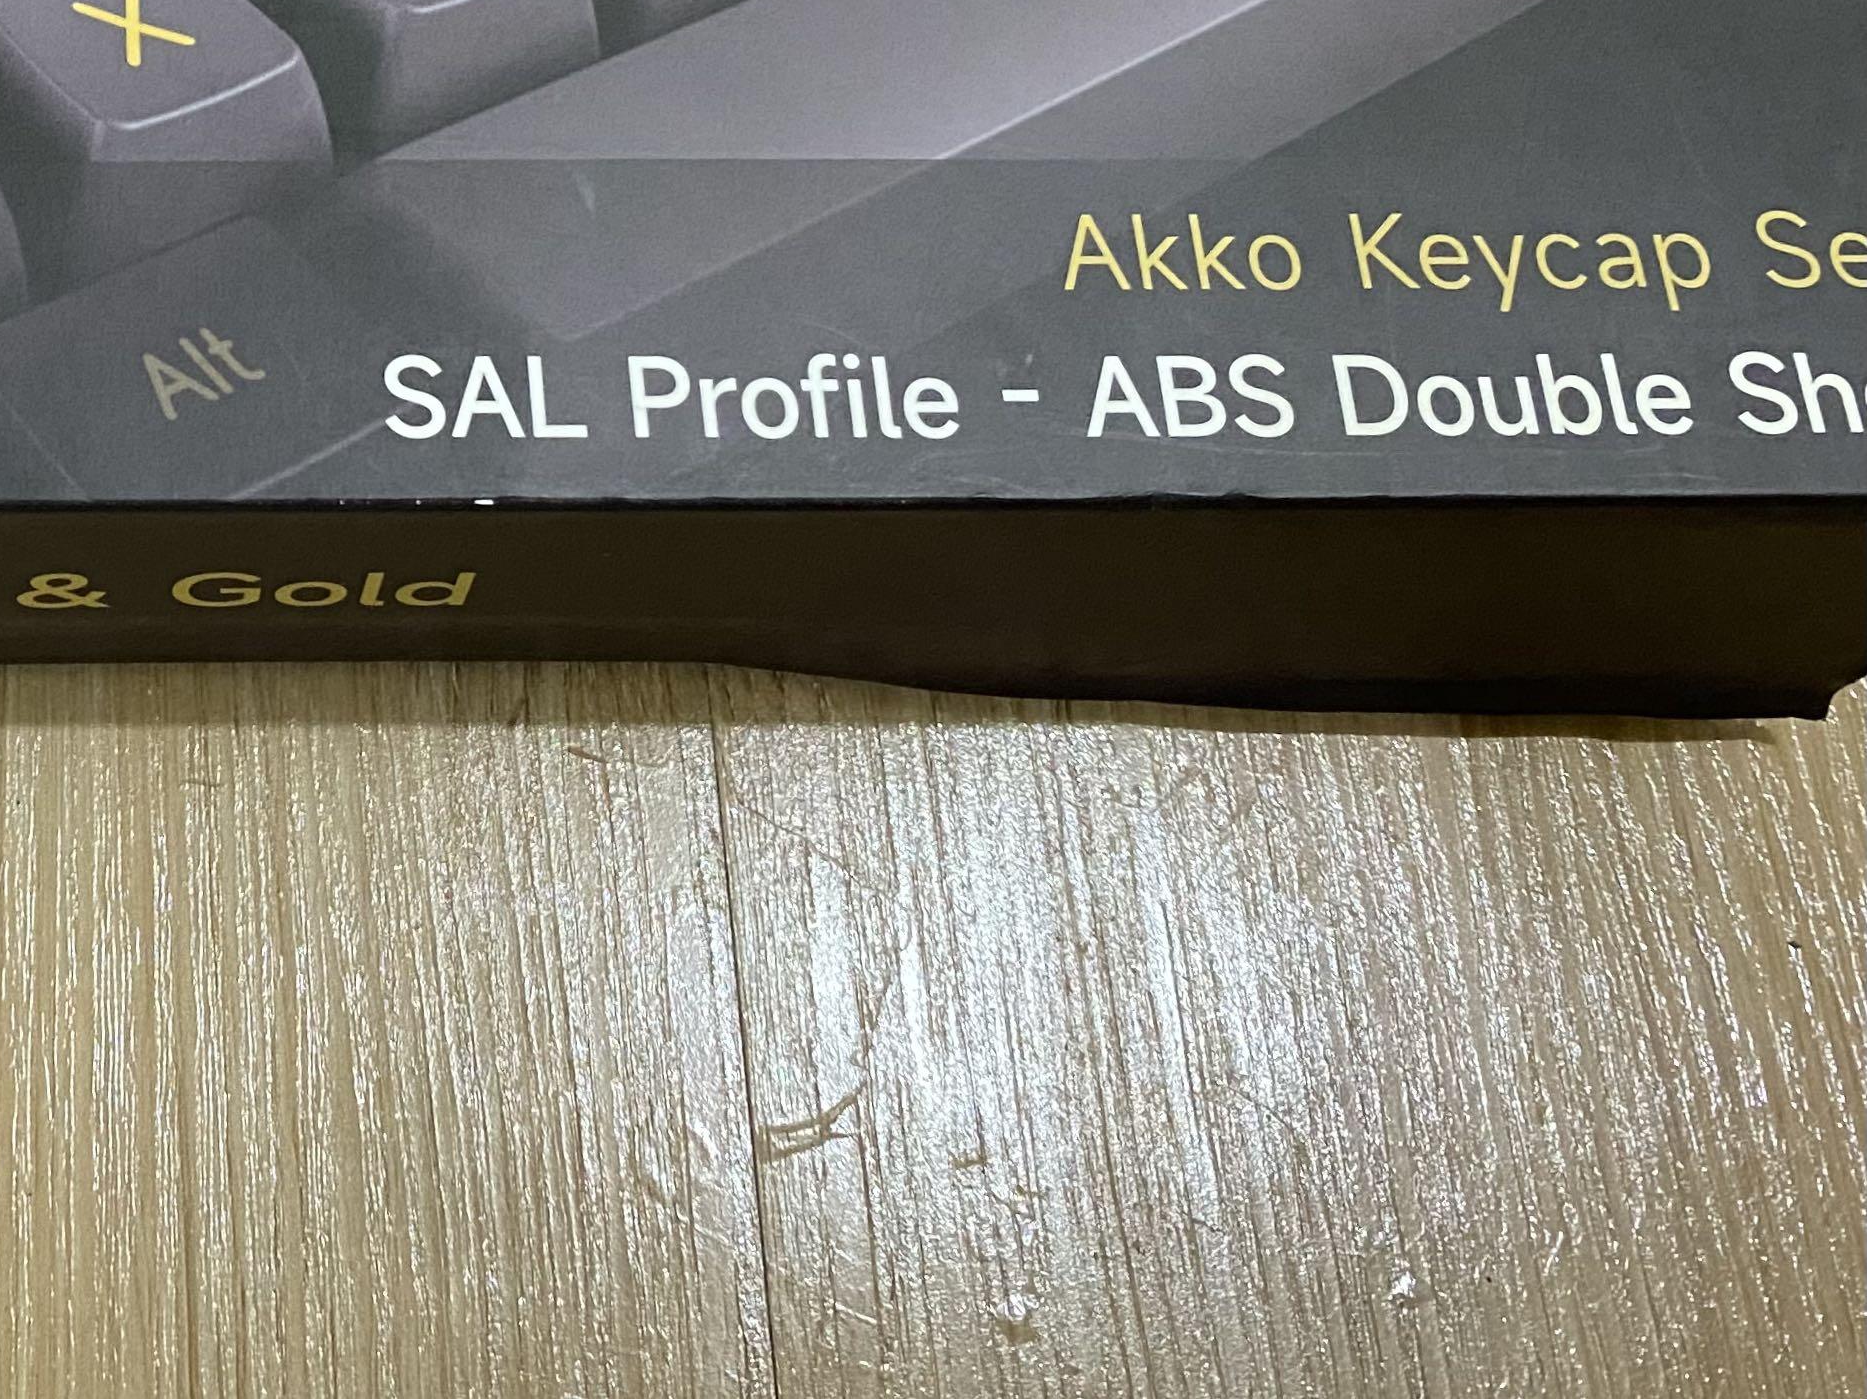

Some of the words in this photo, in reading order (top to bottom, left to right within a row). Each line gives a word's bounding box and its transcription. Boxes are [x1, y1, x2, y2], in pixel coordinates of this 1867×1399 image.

[1064, 213, 1302, 291] Akko
[1348, 212, 1711, 313] Keycap
[142, 327, 266, 421] Alt
[384, 354, 589, 440] SAL
[627, 353, 960, 440] Profile
[1001, 389, 1040, 402] -
[1086, 353, 1295, 438] ABS
[1331, 353, 1694, 437] Double
[1728, 351, 1867, 435] Sh
[16, 573, 109, 609] &
[171, 571, 477, 608] Gold
